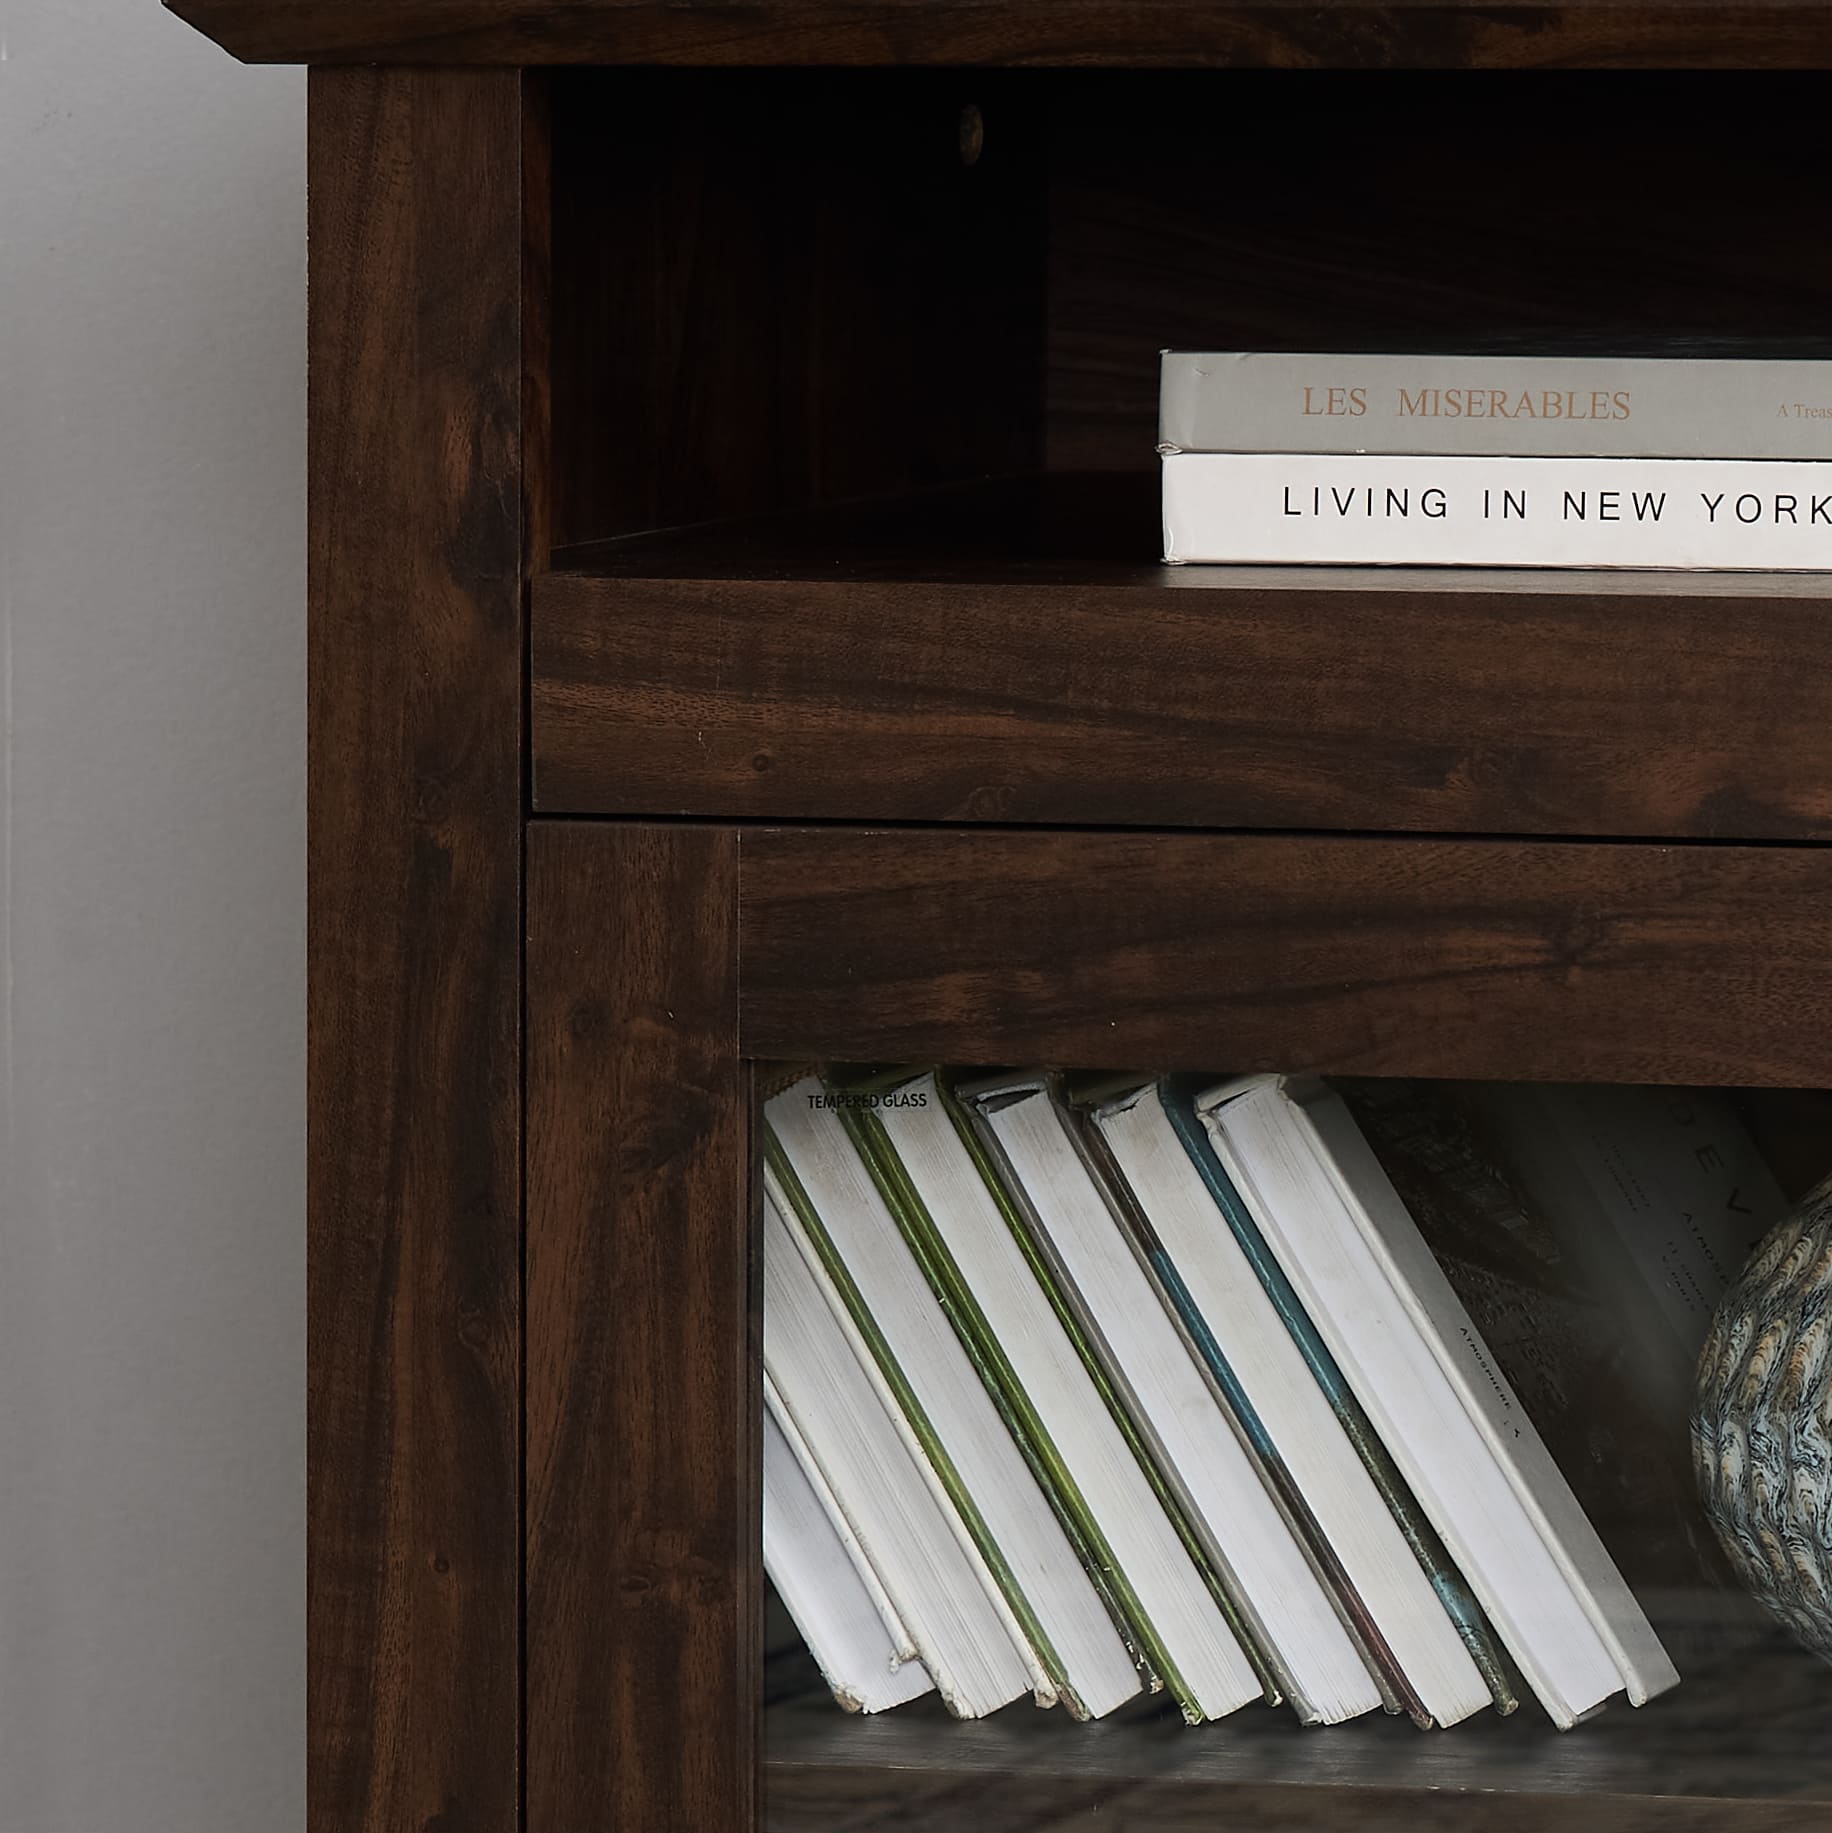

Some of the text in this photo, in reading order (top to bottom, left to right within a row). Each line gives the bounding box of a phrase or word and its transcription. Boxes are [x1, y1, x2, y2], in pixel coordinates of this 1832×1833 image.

[1303, 388, 1629, 420] LES MISERABLES
[1777, 404, 1788, 417] A
[1284, 487, 1832, 524] LIVING IN NEW YORK
[807, 1092, 928, 1110] TEMPERED GLASS
